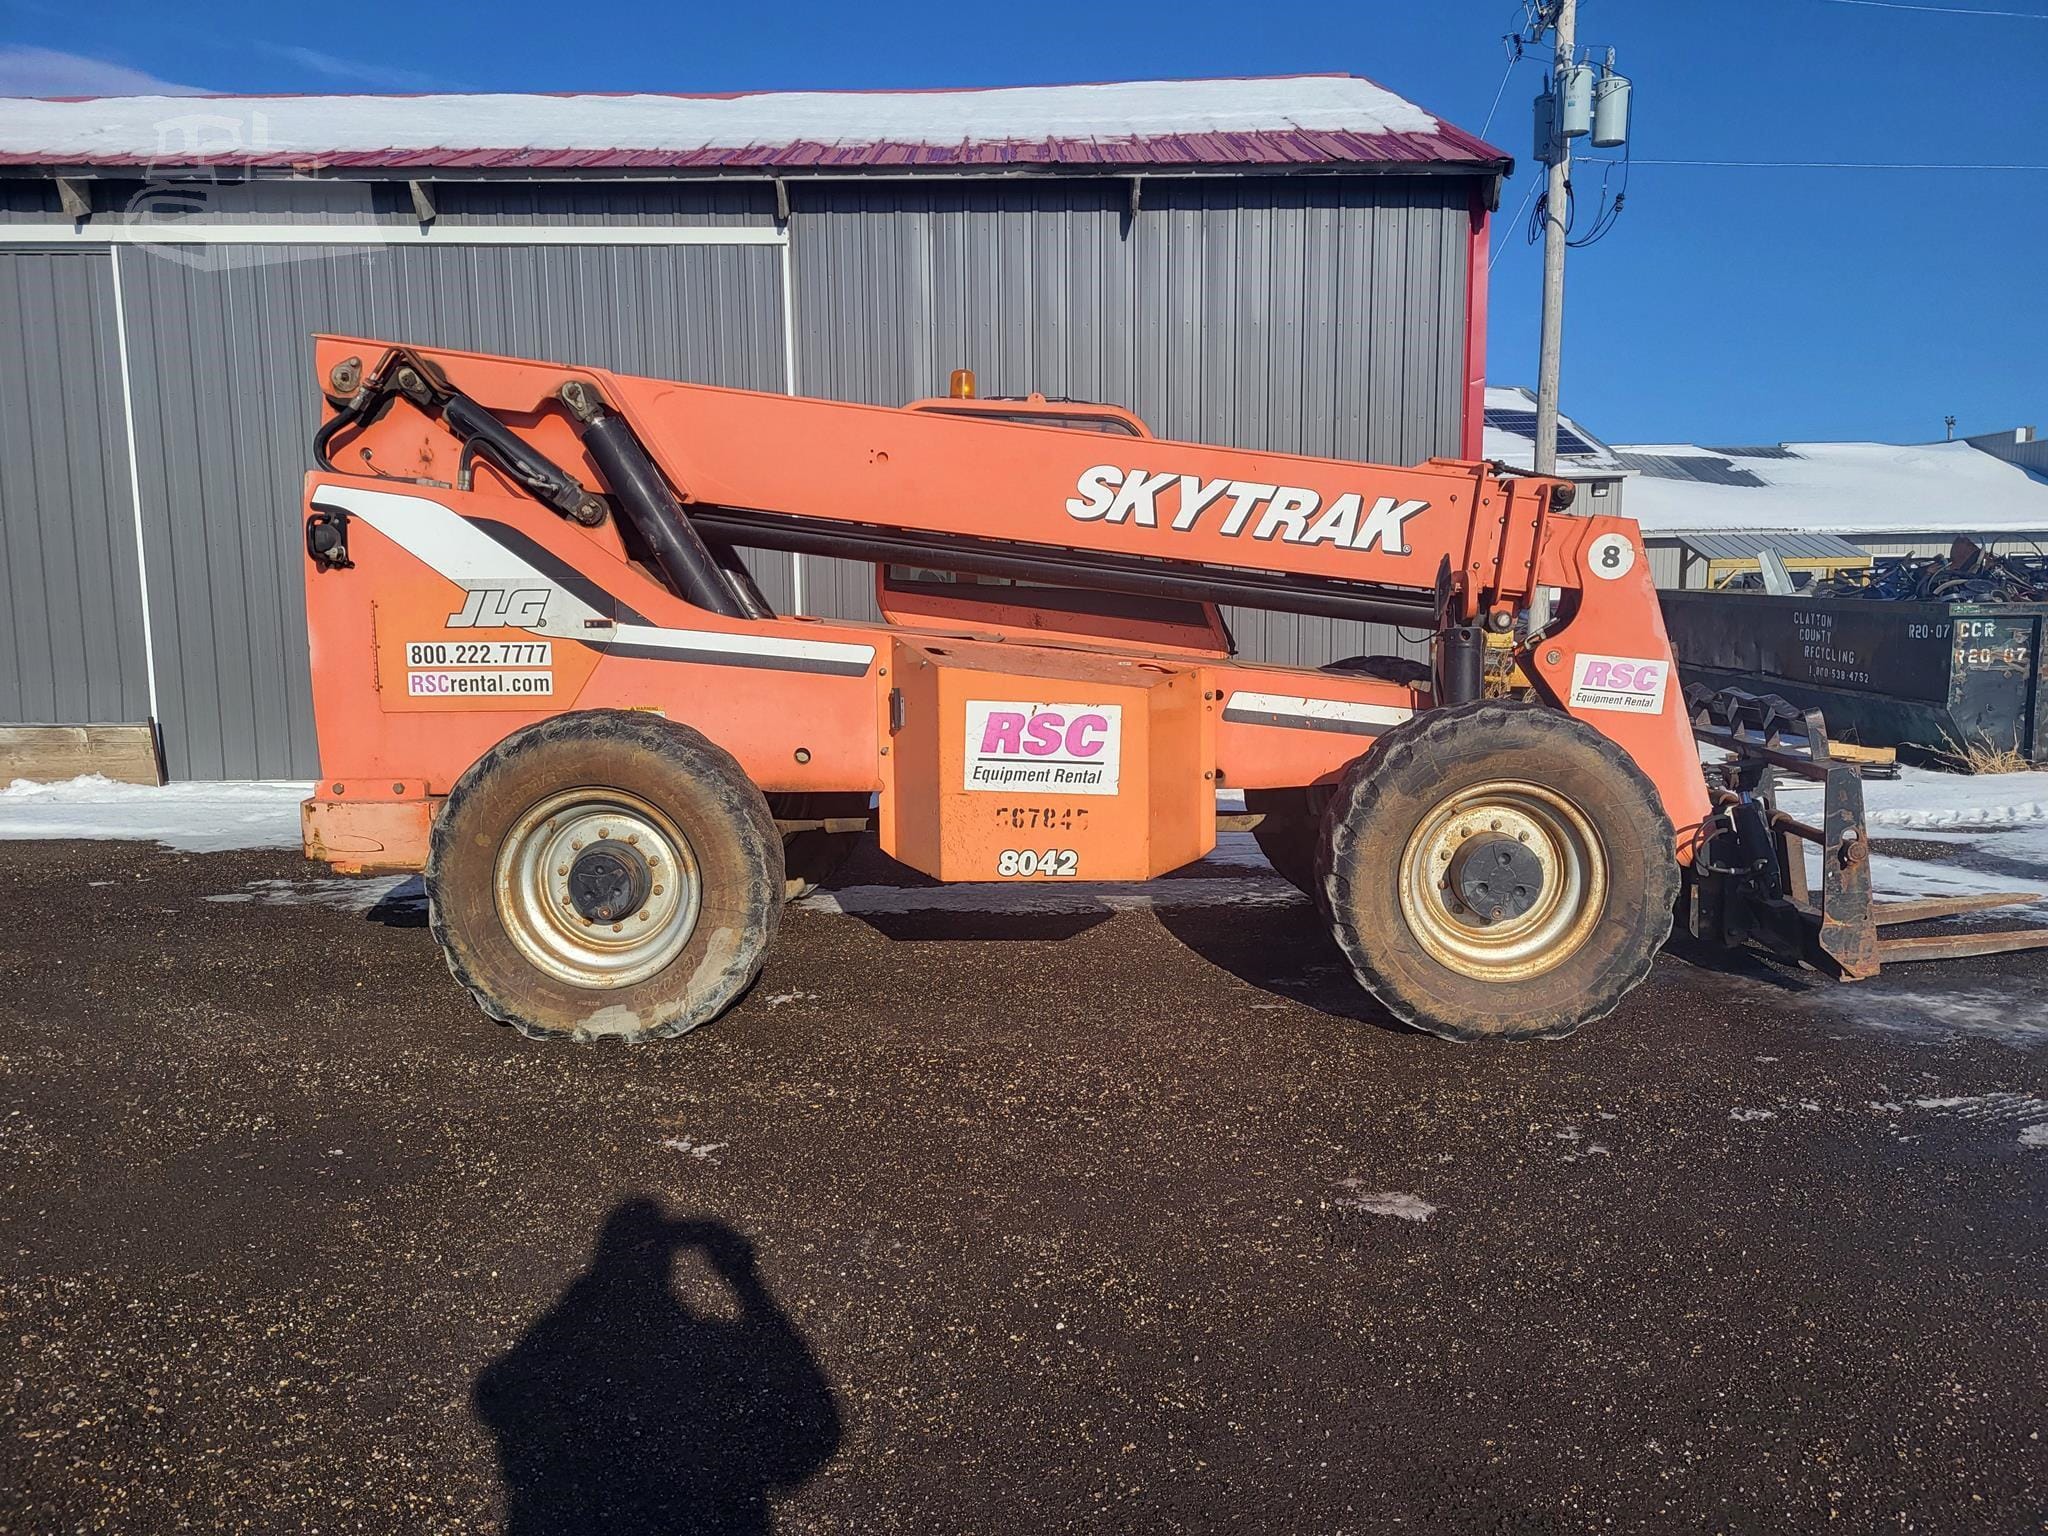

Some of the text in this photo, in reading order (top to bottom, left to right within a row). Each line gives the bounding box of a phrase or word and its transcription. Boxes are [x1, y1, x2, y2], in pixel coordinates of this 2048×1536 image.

[1065, 464, 1432, 555] SKYTRAK
[1602, 545, 1620, 568] 8
[445, 589, 552, 628] JLG
[1793, 611, 1832, 627] CLAYTON
[1799, 628, 1831, 644] COUNTY
[1961, 622, 1996, 637] CCR
[411, 644, 547, 664] 800.222.7777
[411, 674, 550, 693] RSCrental.com
[1582, 661, 1658, 691] RSC
[1576, 692, 1654, 708] Equipment Rental
[980, 711, 1108, 757] RSC
[972, 766, 1102, 784] Equipment Rental
[997, 849, 1079, 877] 8042
